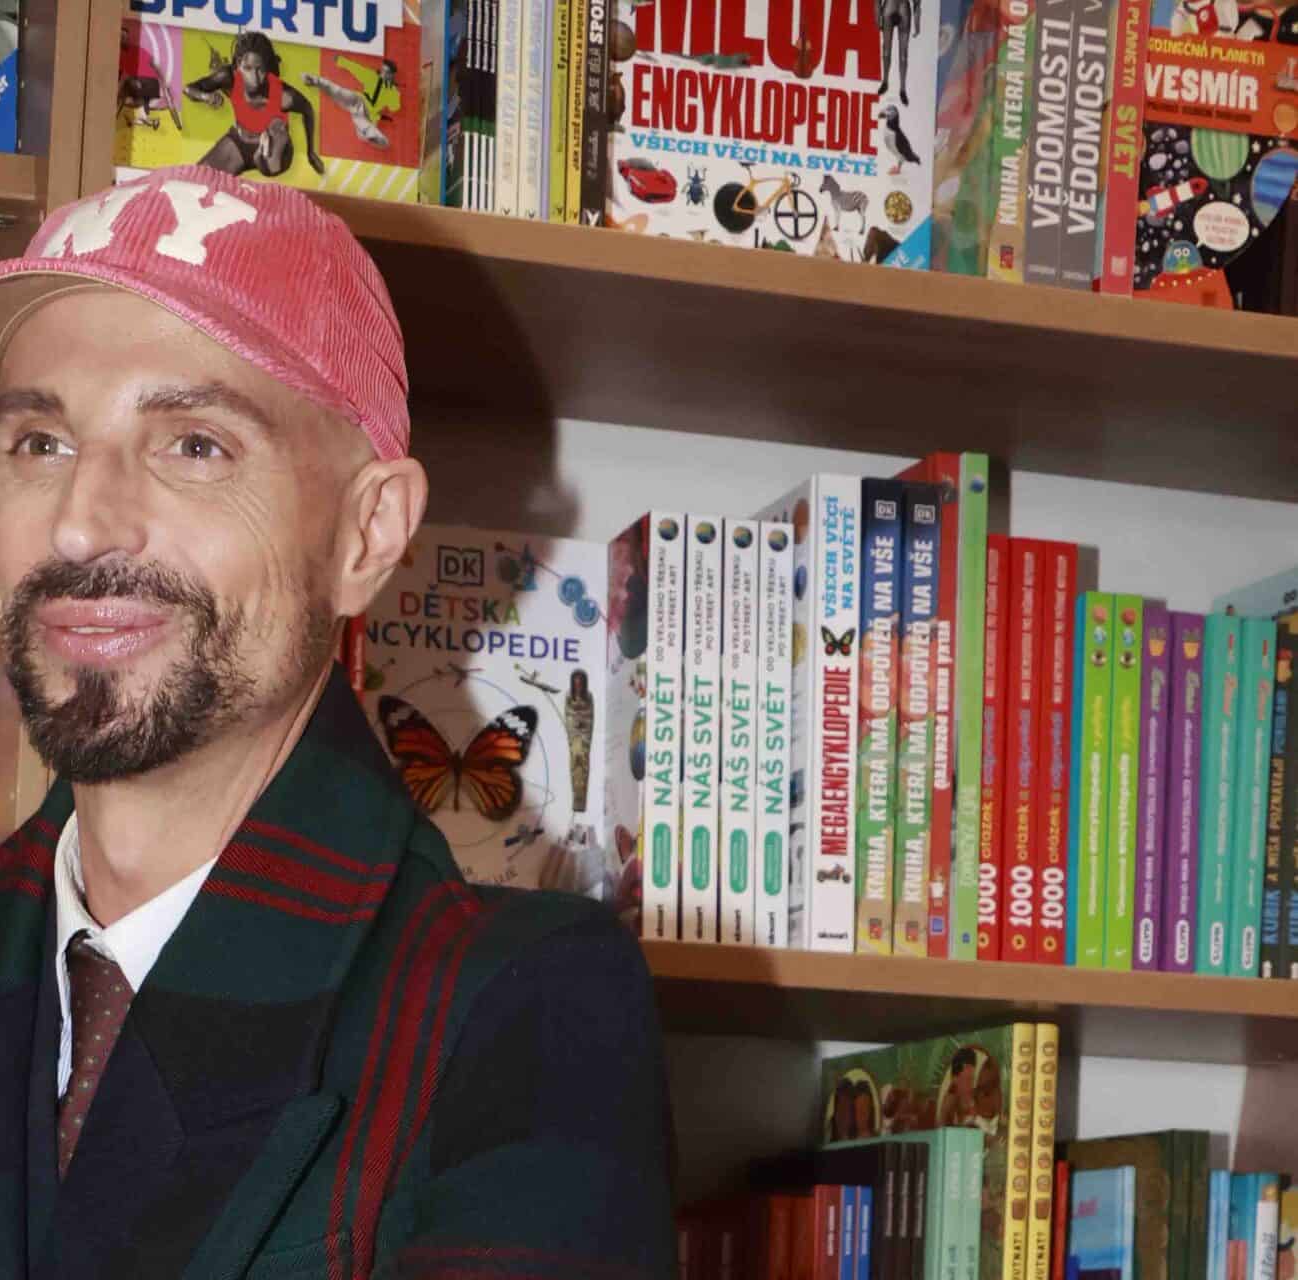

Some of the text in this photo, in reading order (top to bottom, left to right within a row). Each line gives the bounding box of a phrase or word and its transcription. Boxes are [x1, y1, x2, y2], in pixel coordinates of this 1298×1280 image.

[131, 0, 378, 43] ORTU
[1144, 62, 1259, 111] VESMÍR
[1210, 47, 1266, 66] PLANETA
[632, 63, 879, 157] ENCYKLOPEDIE
[998, 24, 1027, 226] KNIHA, KTERÁ MÁ
[1028, 18, 1071, 229] VĚDOMOSTI
[1063, 25, 1107, 235] VĚDOMOSTI
[1113, 104, 1138, 179] SVĚT
[630, 130, 878, 178] VŠECH VĚCÍ NA SVĚTĚ
[444, 552, 478, 579] DK
[822, 495, 839, 619] VŠECH VĚCÍ
[840, 506, 855, 611] NA SVĚTĚ
[398, 588, 522, 627] DĚTSKÁ
[364, 620, 581, 664] NCYKLOPEDIE
[649, 672, 676, 742] SVĚT
[688, 674, 714, 745] SVĚT
[726, 679, 751, 748] SVĚT
[760, 681, 786, 751] SVĚT
[863, 535, 894, 901] KNIHA, KTERÁ MÁ ODPOVĚĎ NA VŠE
[902, 539, 933, 904] KNIHA, KTERÁ MÁ ODPOVĚĎ NA VŠE
[647, 751, 673, 807] NÁŠ
[686, 754, 712, 809] NÁŠ
[724, 757, 750, 812] NÁŠ
[758, 759, 785, 815] NÁŠ
[820, 665, 851, 857] MEGAENCYKLOPEDIE
[1015, 804, 1030, 861] otázek
[1047, 807, 1062, 864] otázek
[1009, 865, 1034, 928] 1000
[1041, 866, 1065, 929] 1000
